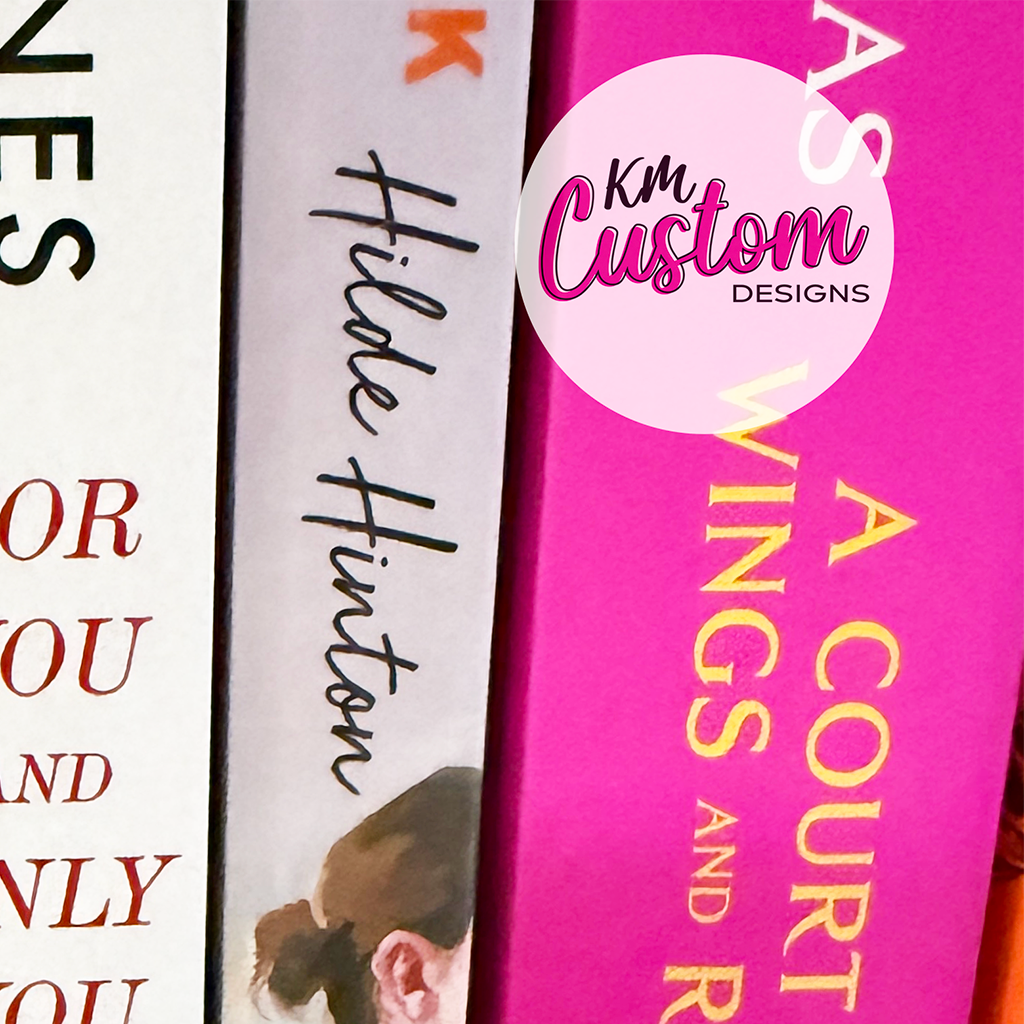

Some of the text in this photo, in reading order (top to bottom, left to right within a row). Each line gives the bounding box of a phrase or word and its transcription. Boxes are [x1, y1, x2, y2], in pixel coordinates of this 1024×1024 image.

[301, 149, 480, 796] Hilde Hinton
[685, 360, 810, 761] WINGS
[828, 478, 918, 567] A
[687, 798, 739, 925] AND
[779, 620, 901, 1013] COURT
